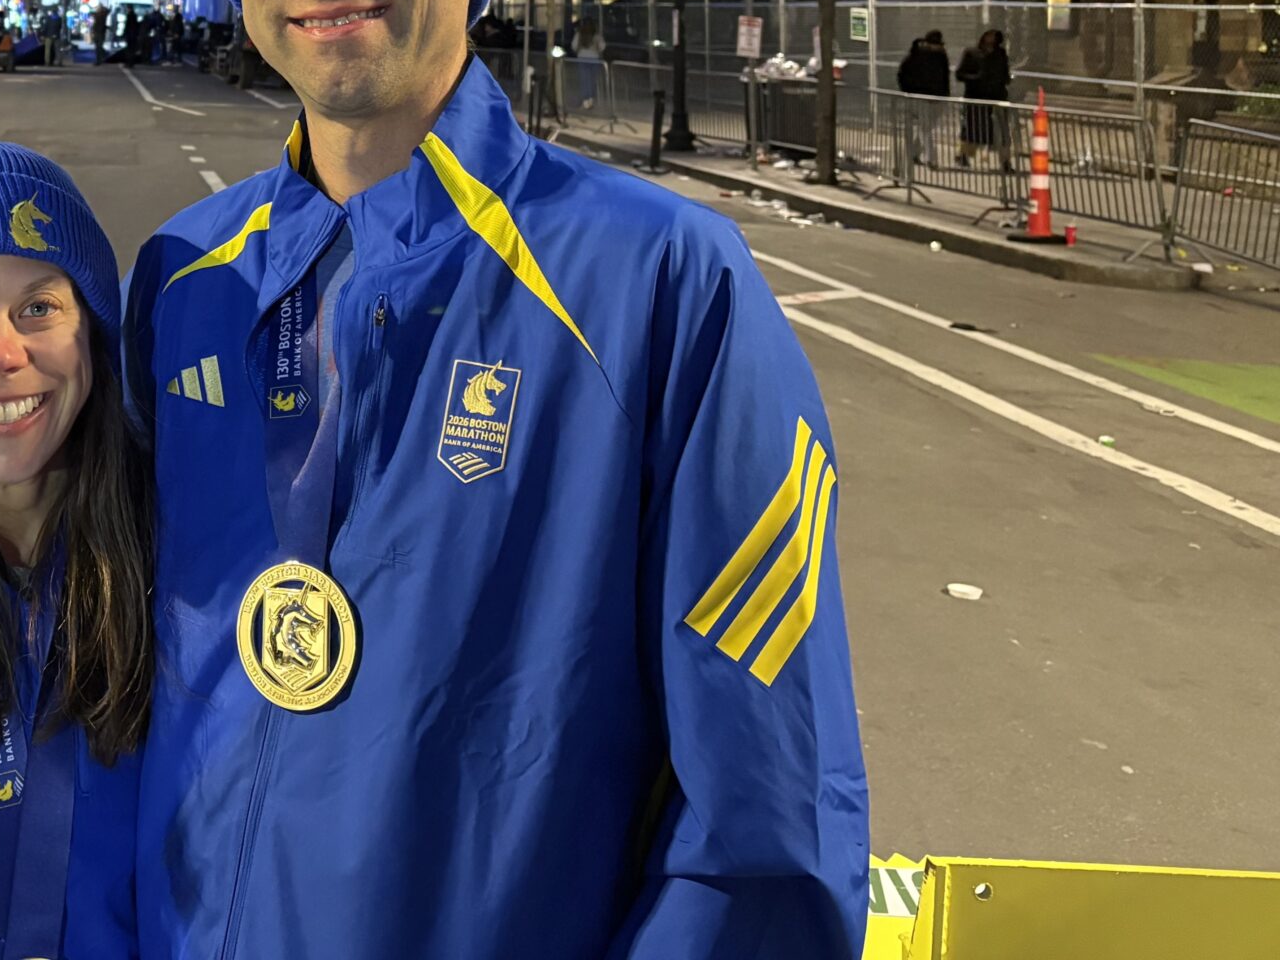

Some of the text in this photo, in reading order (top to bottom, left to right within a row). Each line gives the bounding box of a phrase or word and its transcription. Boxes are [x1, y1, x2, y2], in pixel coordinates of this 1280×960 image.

[294, 287, 303, 377] BANK OF AMERIC
[448, 414, 507, 433] 2026 BOSTON
[445, 424, 505, 445] MARATHON
[443, 438, 503, 454] BANK OF AMERICA
[3, 727, 15, 763] BANK
